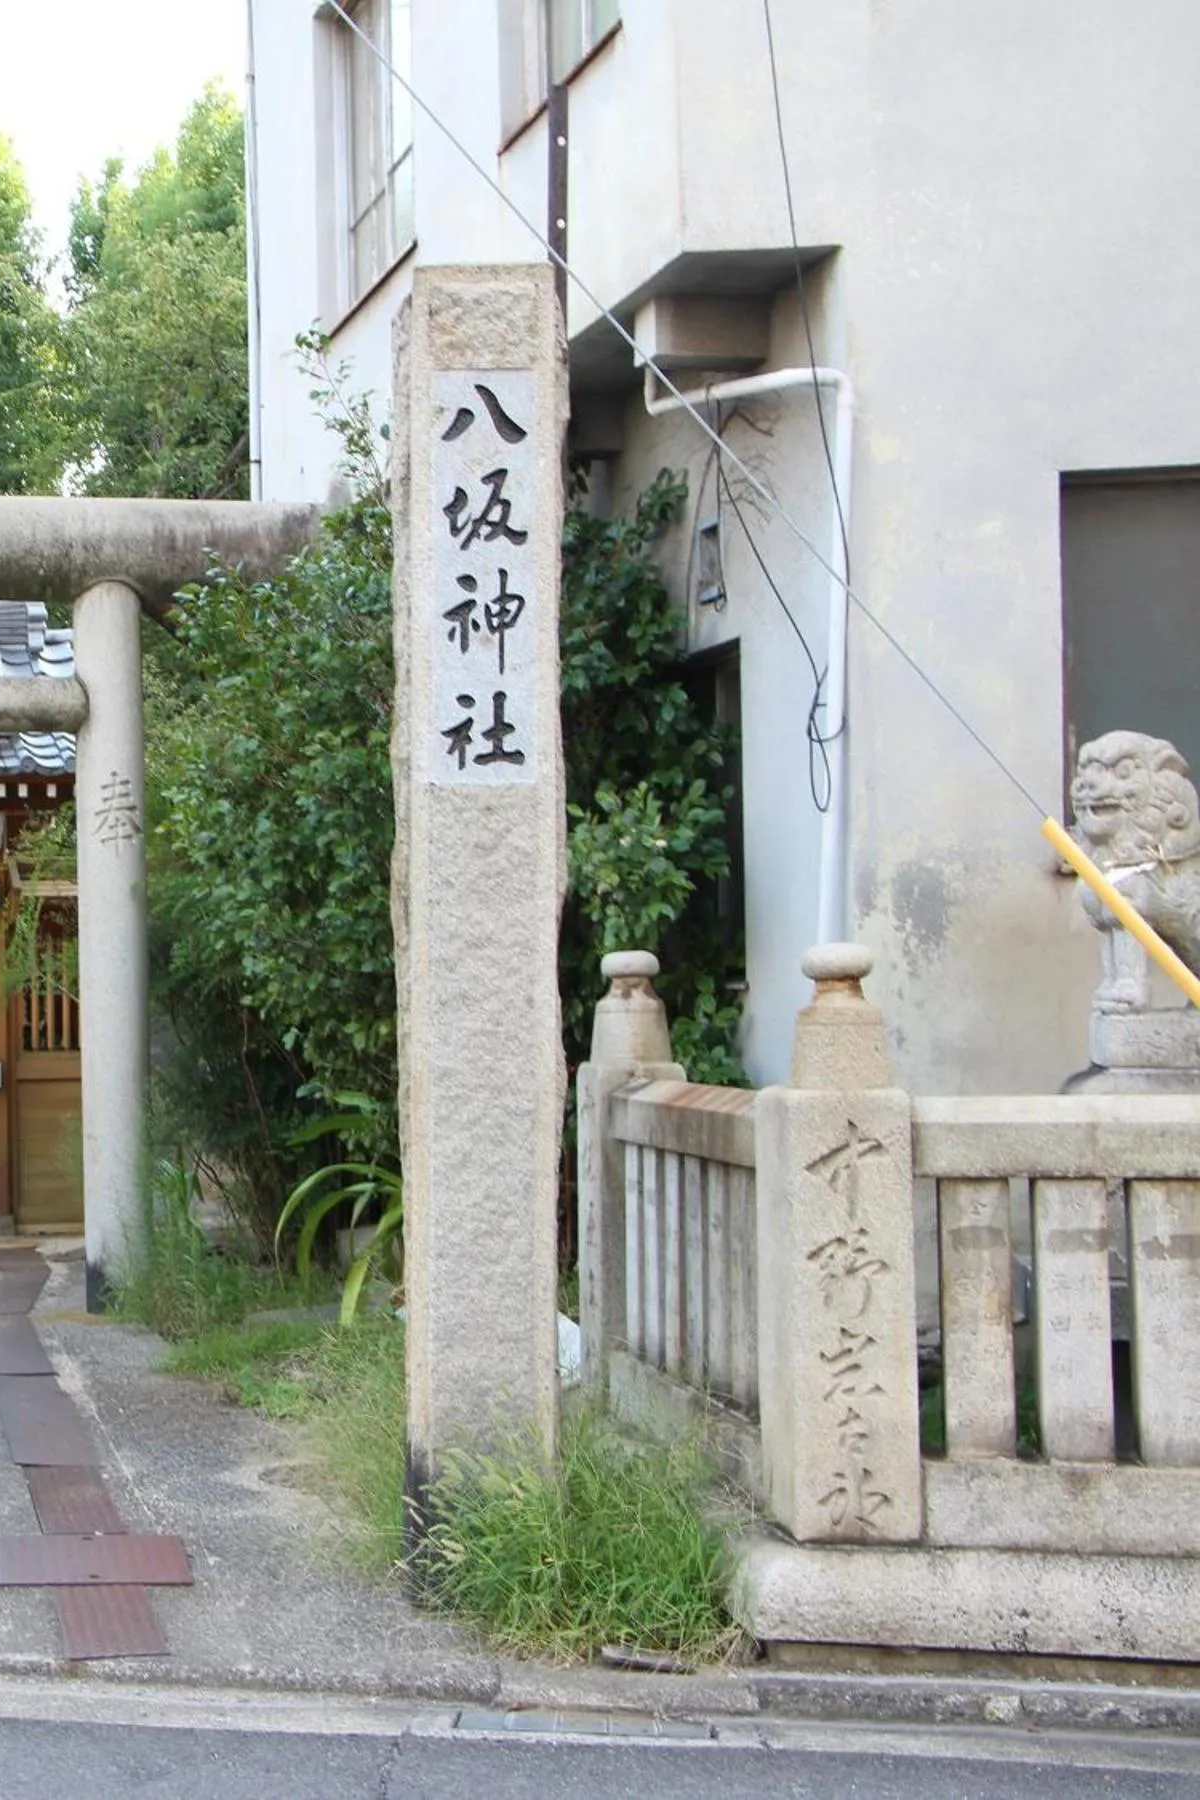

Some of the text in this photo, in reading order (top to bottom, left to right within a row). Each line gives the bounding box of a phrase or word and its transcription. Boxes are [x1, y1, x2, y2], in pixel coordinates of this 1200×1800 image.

[440, 383, 529, 771] 八坂神社
[91, 770, 146, 858] 奉
